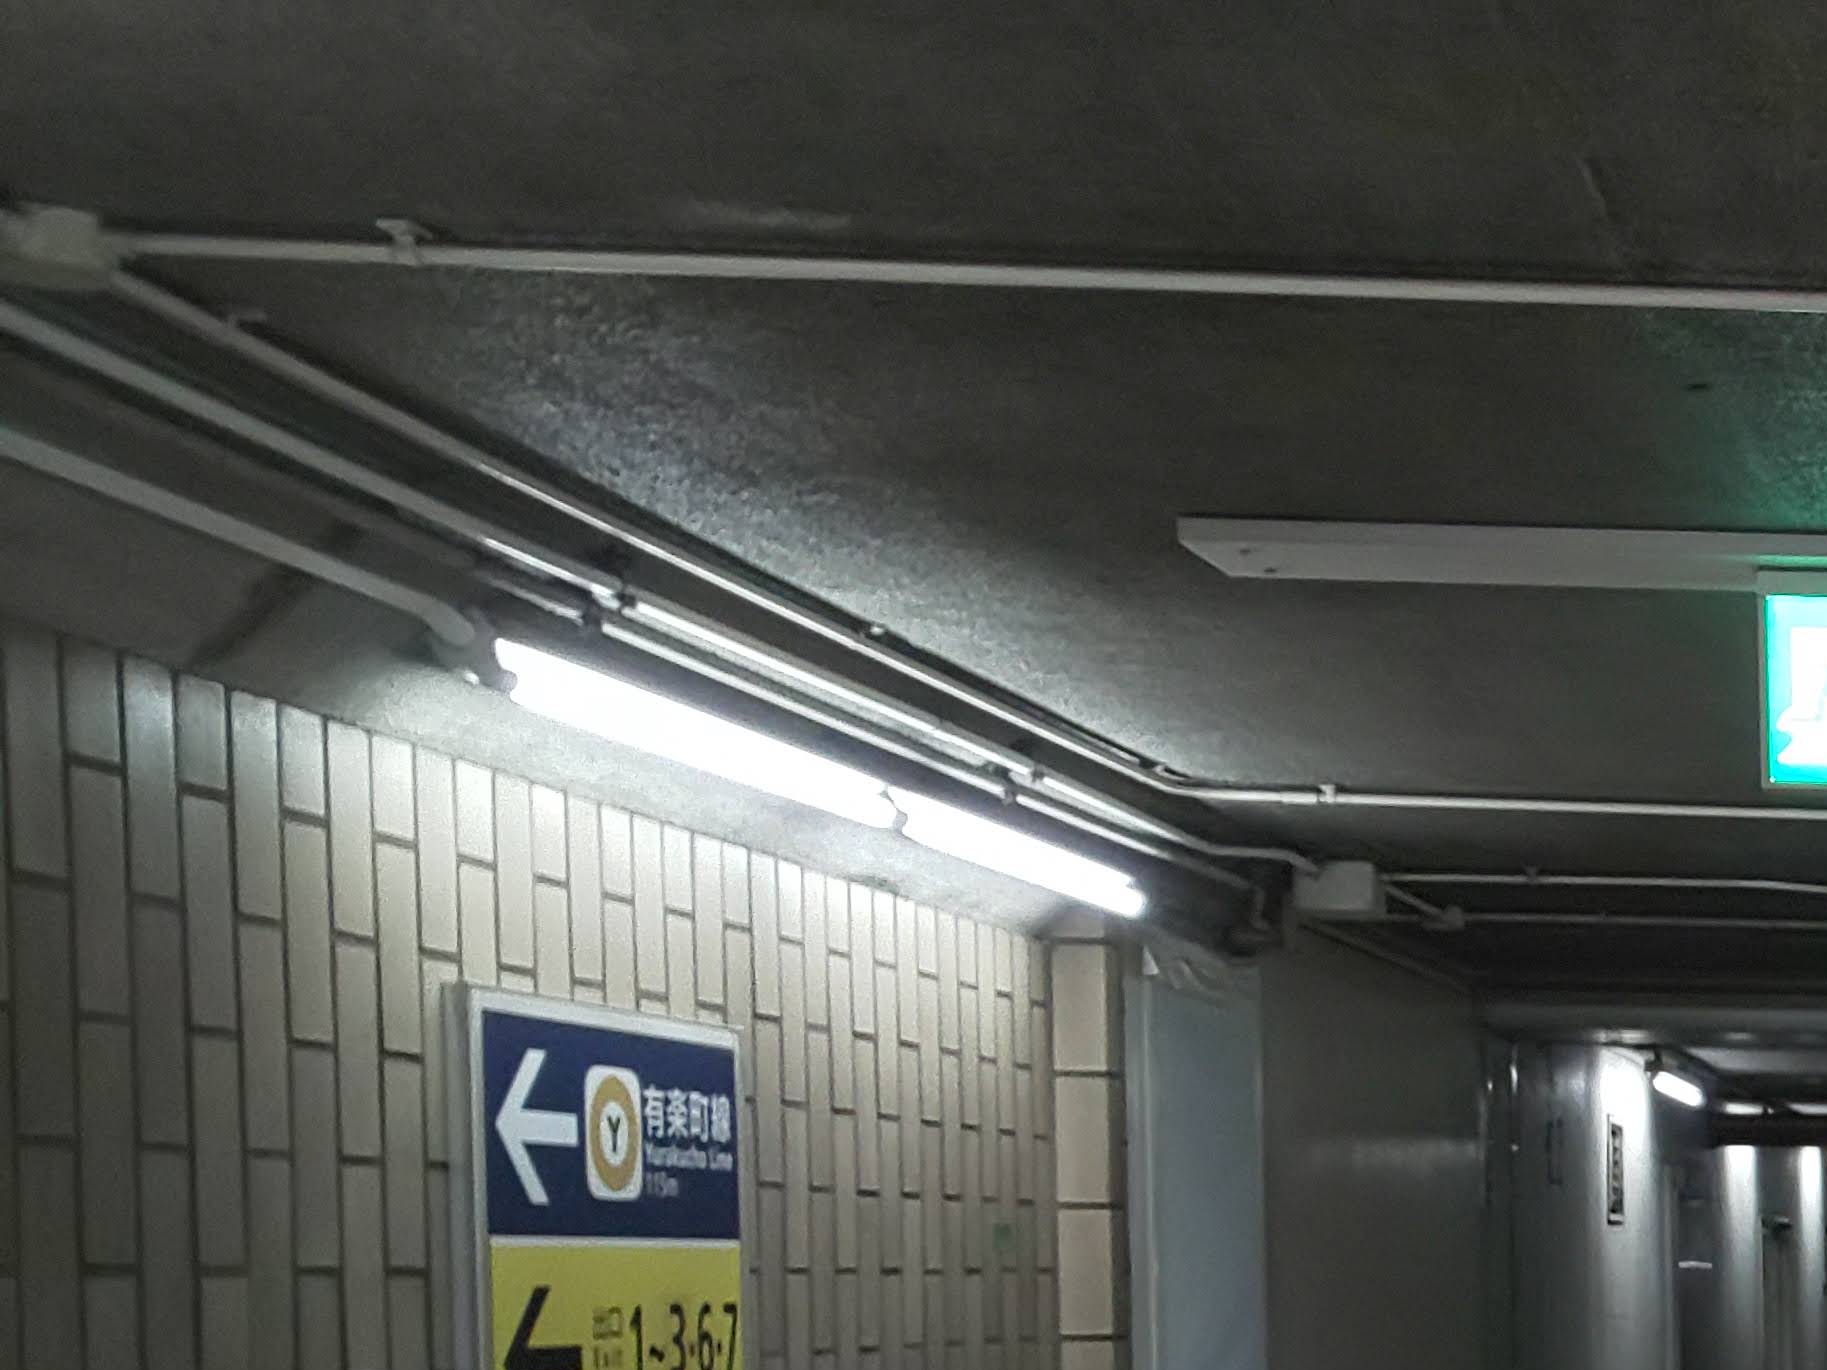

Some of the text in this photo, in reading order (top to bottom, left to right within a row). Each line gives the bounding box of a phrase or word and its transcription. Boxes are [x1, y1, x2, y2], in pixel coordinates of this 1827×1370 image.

[607, 1115, 621, 1153] Y
[643, 1084, 731, 1143] 有楽町線
